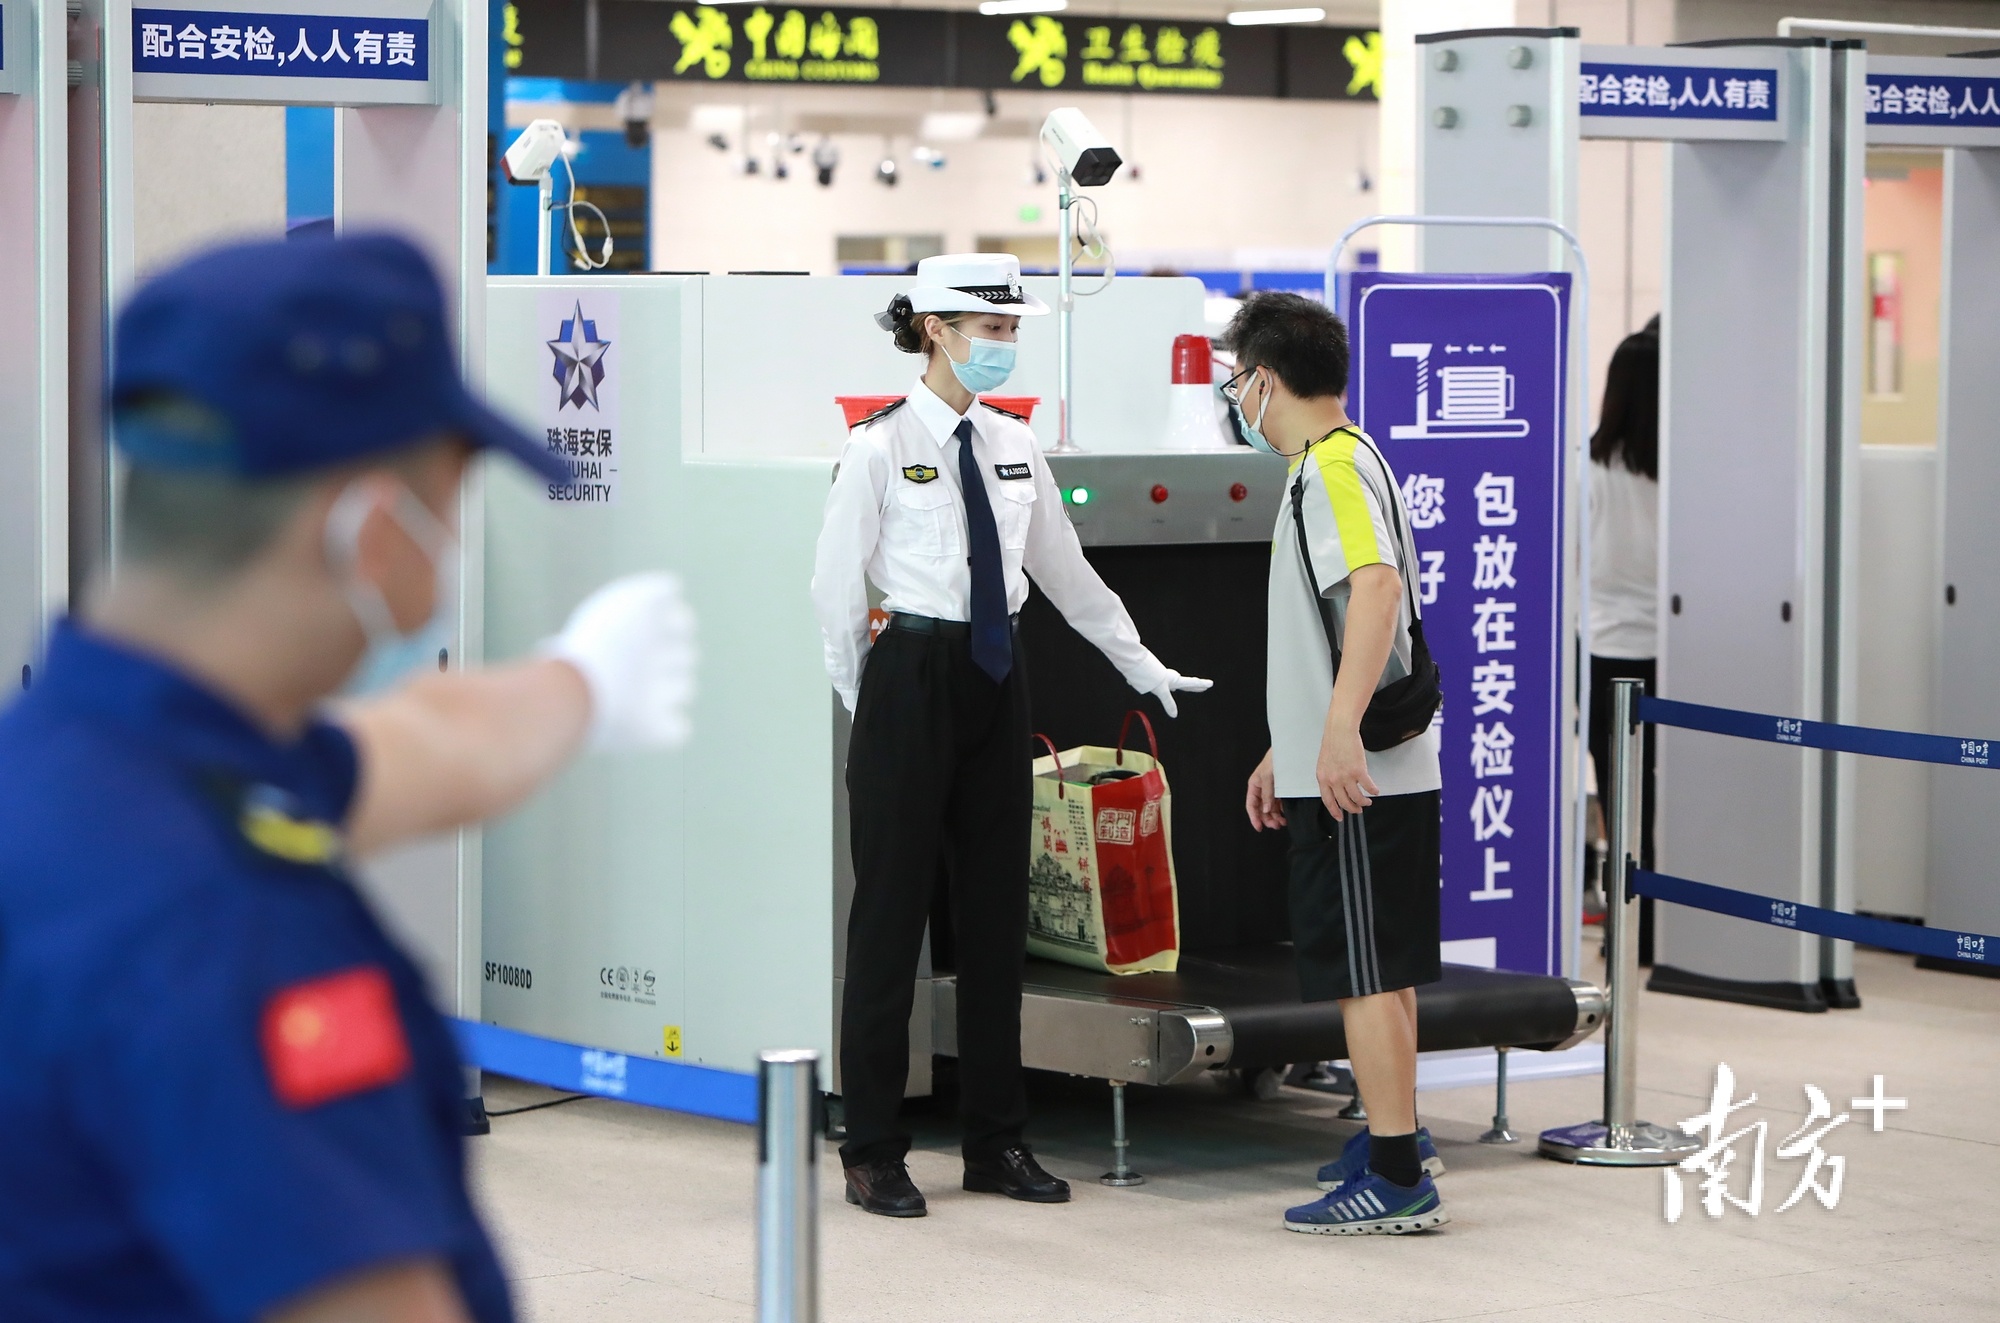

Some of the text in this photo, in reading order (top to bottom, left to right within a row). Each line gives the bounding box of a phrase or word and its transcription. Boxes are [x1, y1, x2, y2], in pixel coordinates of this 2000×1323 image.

[141, 23, 416, 67] 配合安检,人人有责
[547, 427, 612, 457] 珠海安保
[548, 484, 611, 502] SECURITY
[1470, 472, 1518, 901] 包放在安检仪上
[1961, 756, 1989, 765] CHINA PORT
[1957, 950, 1985, 961] CHINA PORT
[485, 961, 532, 990] SF10080D
